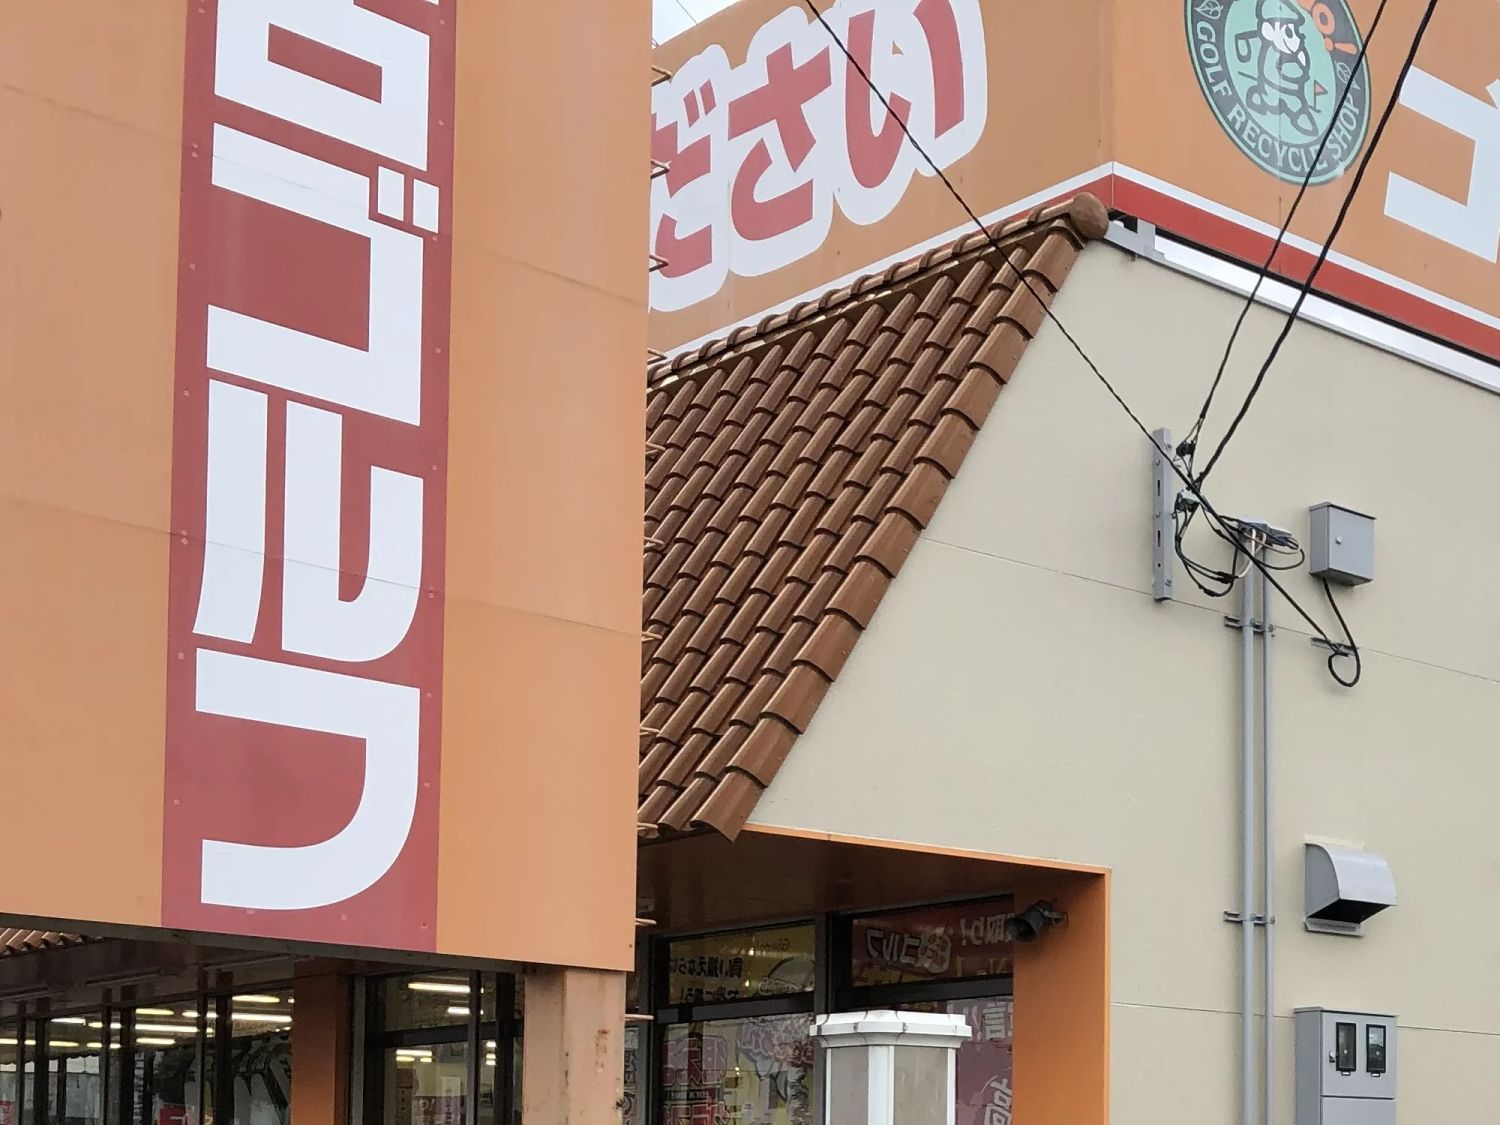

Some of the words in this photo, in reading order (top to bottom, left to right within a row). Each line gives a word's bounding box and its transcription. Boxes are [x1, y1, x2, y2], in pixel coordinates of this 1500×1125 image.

[1195, 20, 1233, 97] GOLF
[1226, 103, 1329, 173] RECYCLE
[1325, 93, 1361, 161] SHOP
